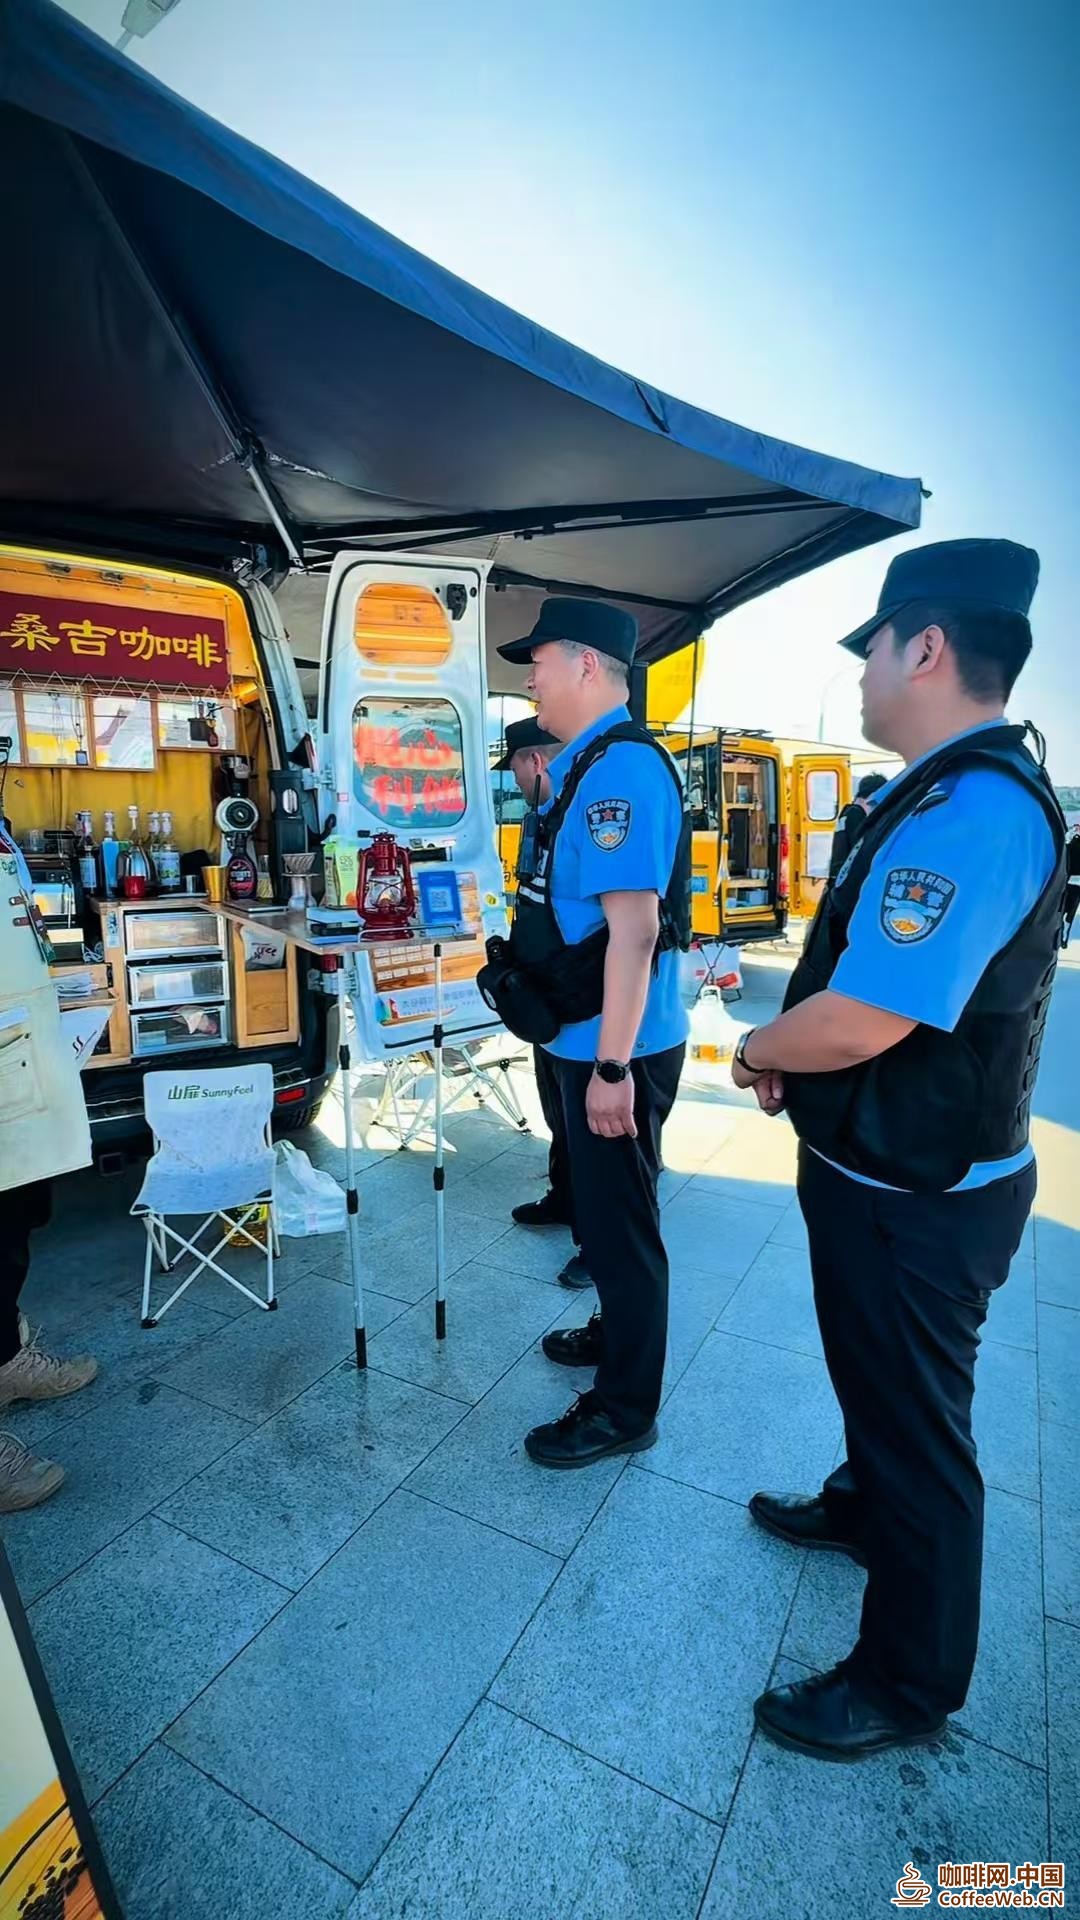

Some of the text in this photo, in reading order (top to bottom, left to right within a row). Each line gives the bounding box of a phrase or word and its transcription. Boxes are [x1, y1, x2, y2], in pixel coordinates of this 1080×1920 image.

[0, 613, 223, 668] 桑吉咖啡
[201, 1085, 253, 1099] SunnyFeel
